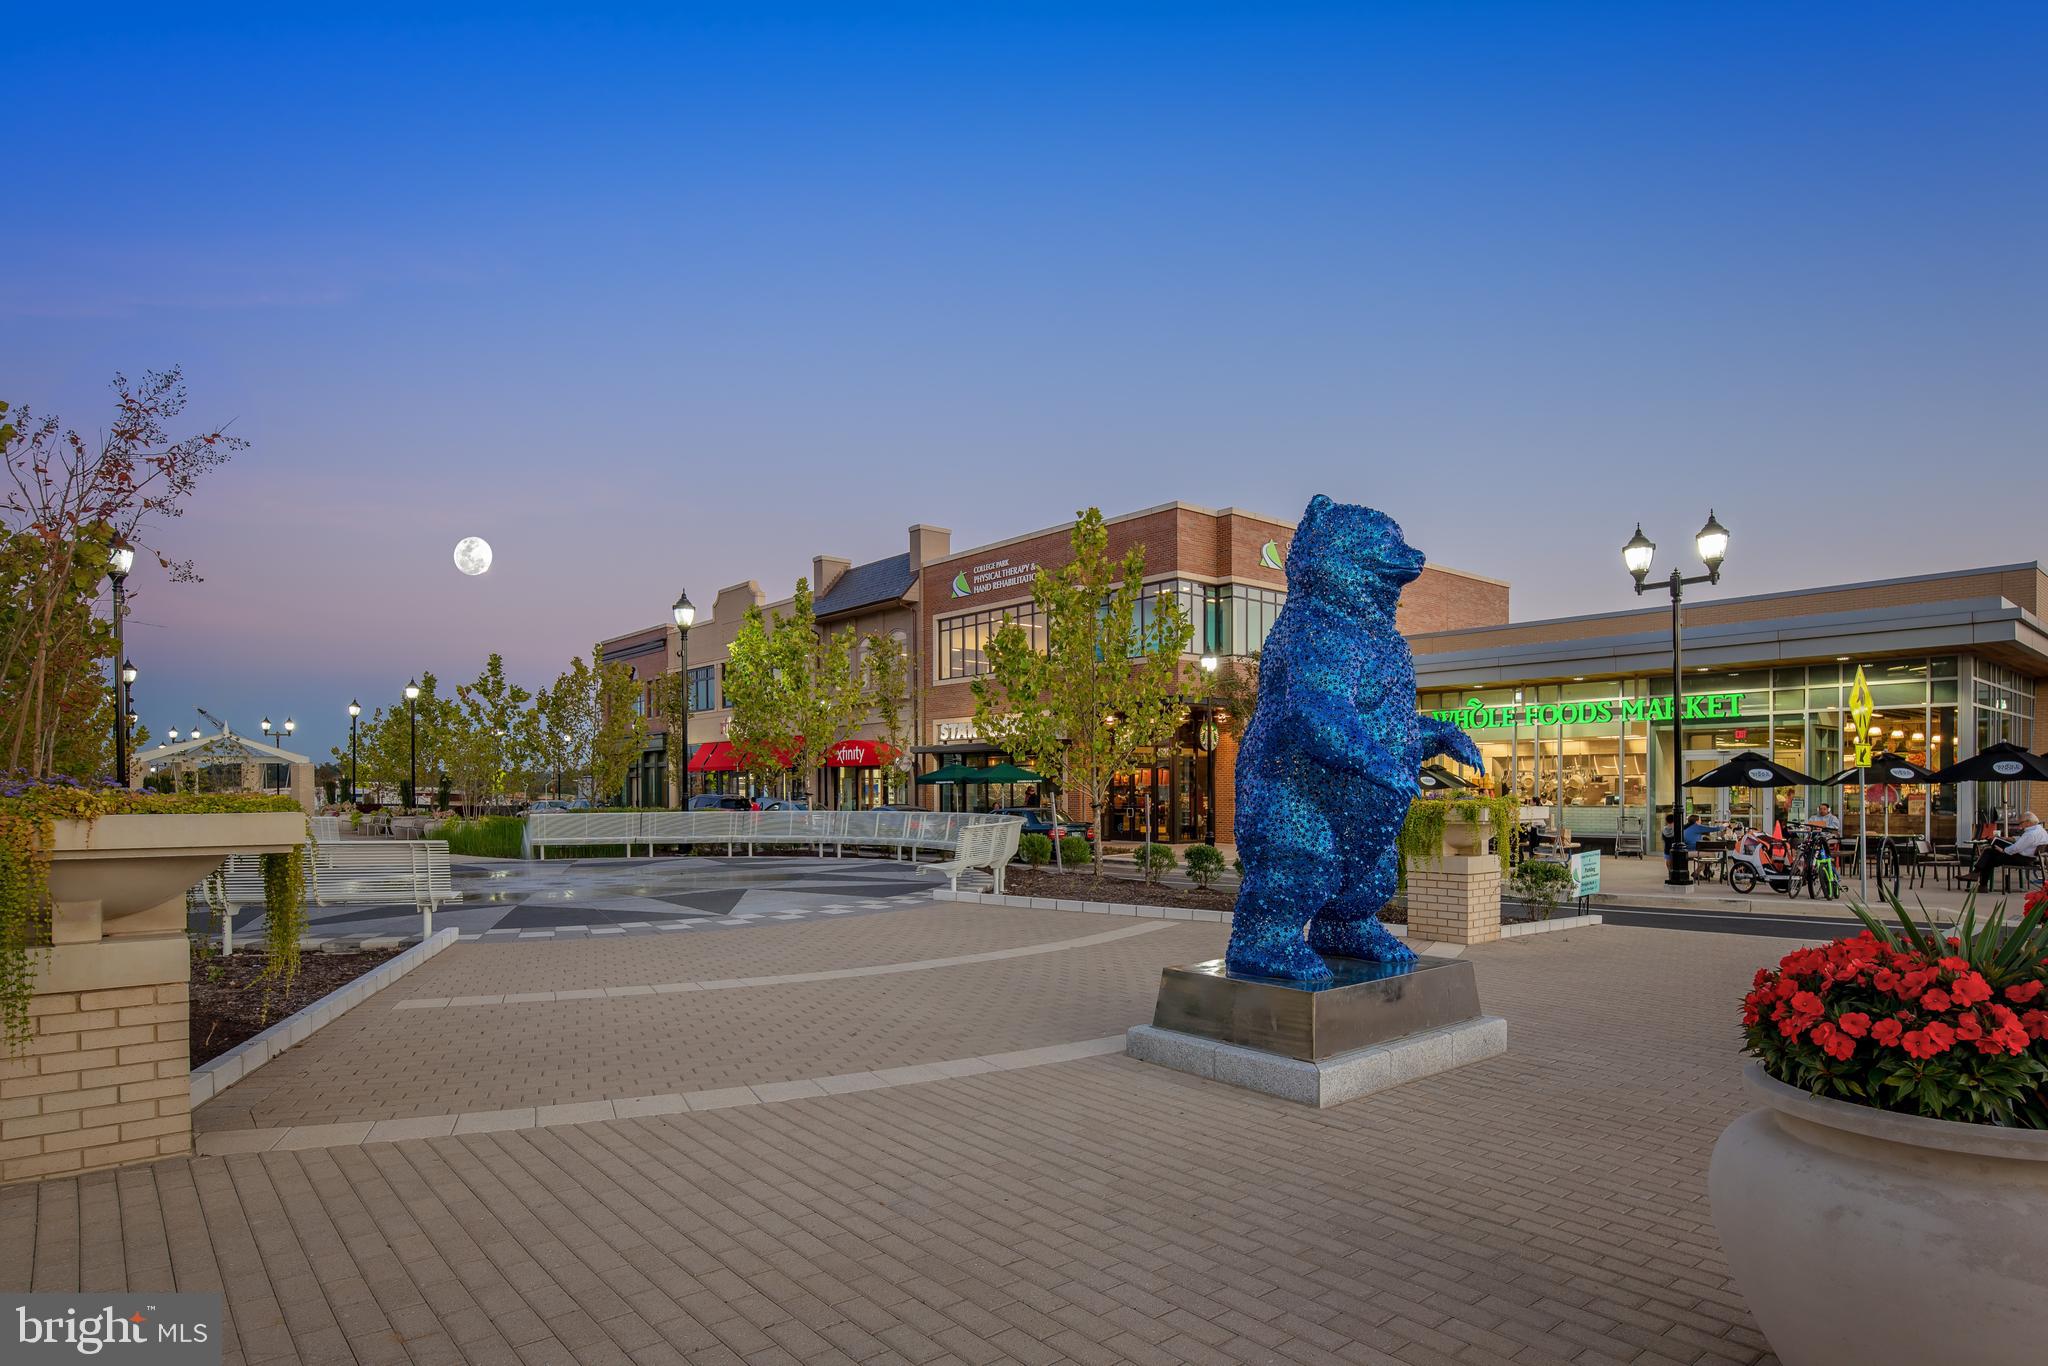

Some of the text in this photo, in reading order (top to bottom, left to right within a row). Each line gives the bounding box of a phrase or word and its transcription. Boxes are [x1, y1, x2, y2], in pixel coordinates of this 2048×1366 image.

[973, 559, 1010, 574] COLLEGE PARK
[973, 563, 1036, 584] PHYSICAL THERAPY &
[973, 573, 1036, 594] HAND REHABILITATIO
[1525, 701, 1612, 726] FOODS
[837, 747, 865, 763] xfinity
